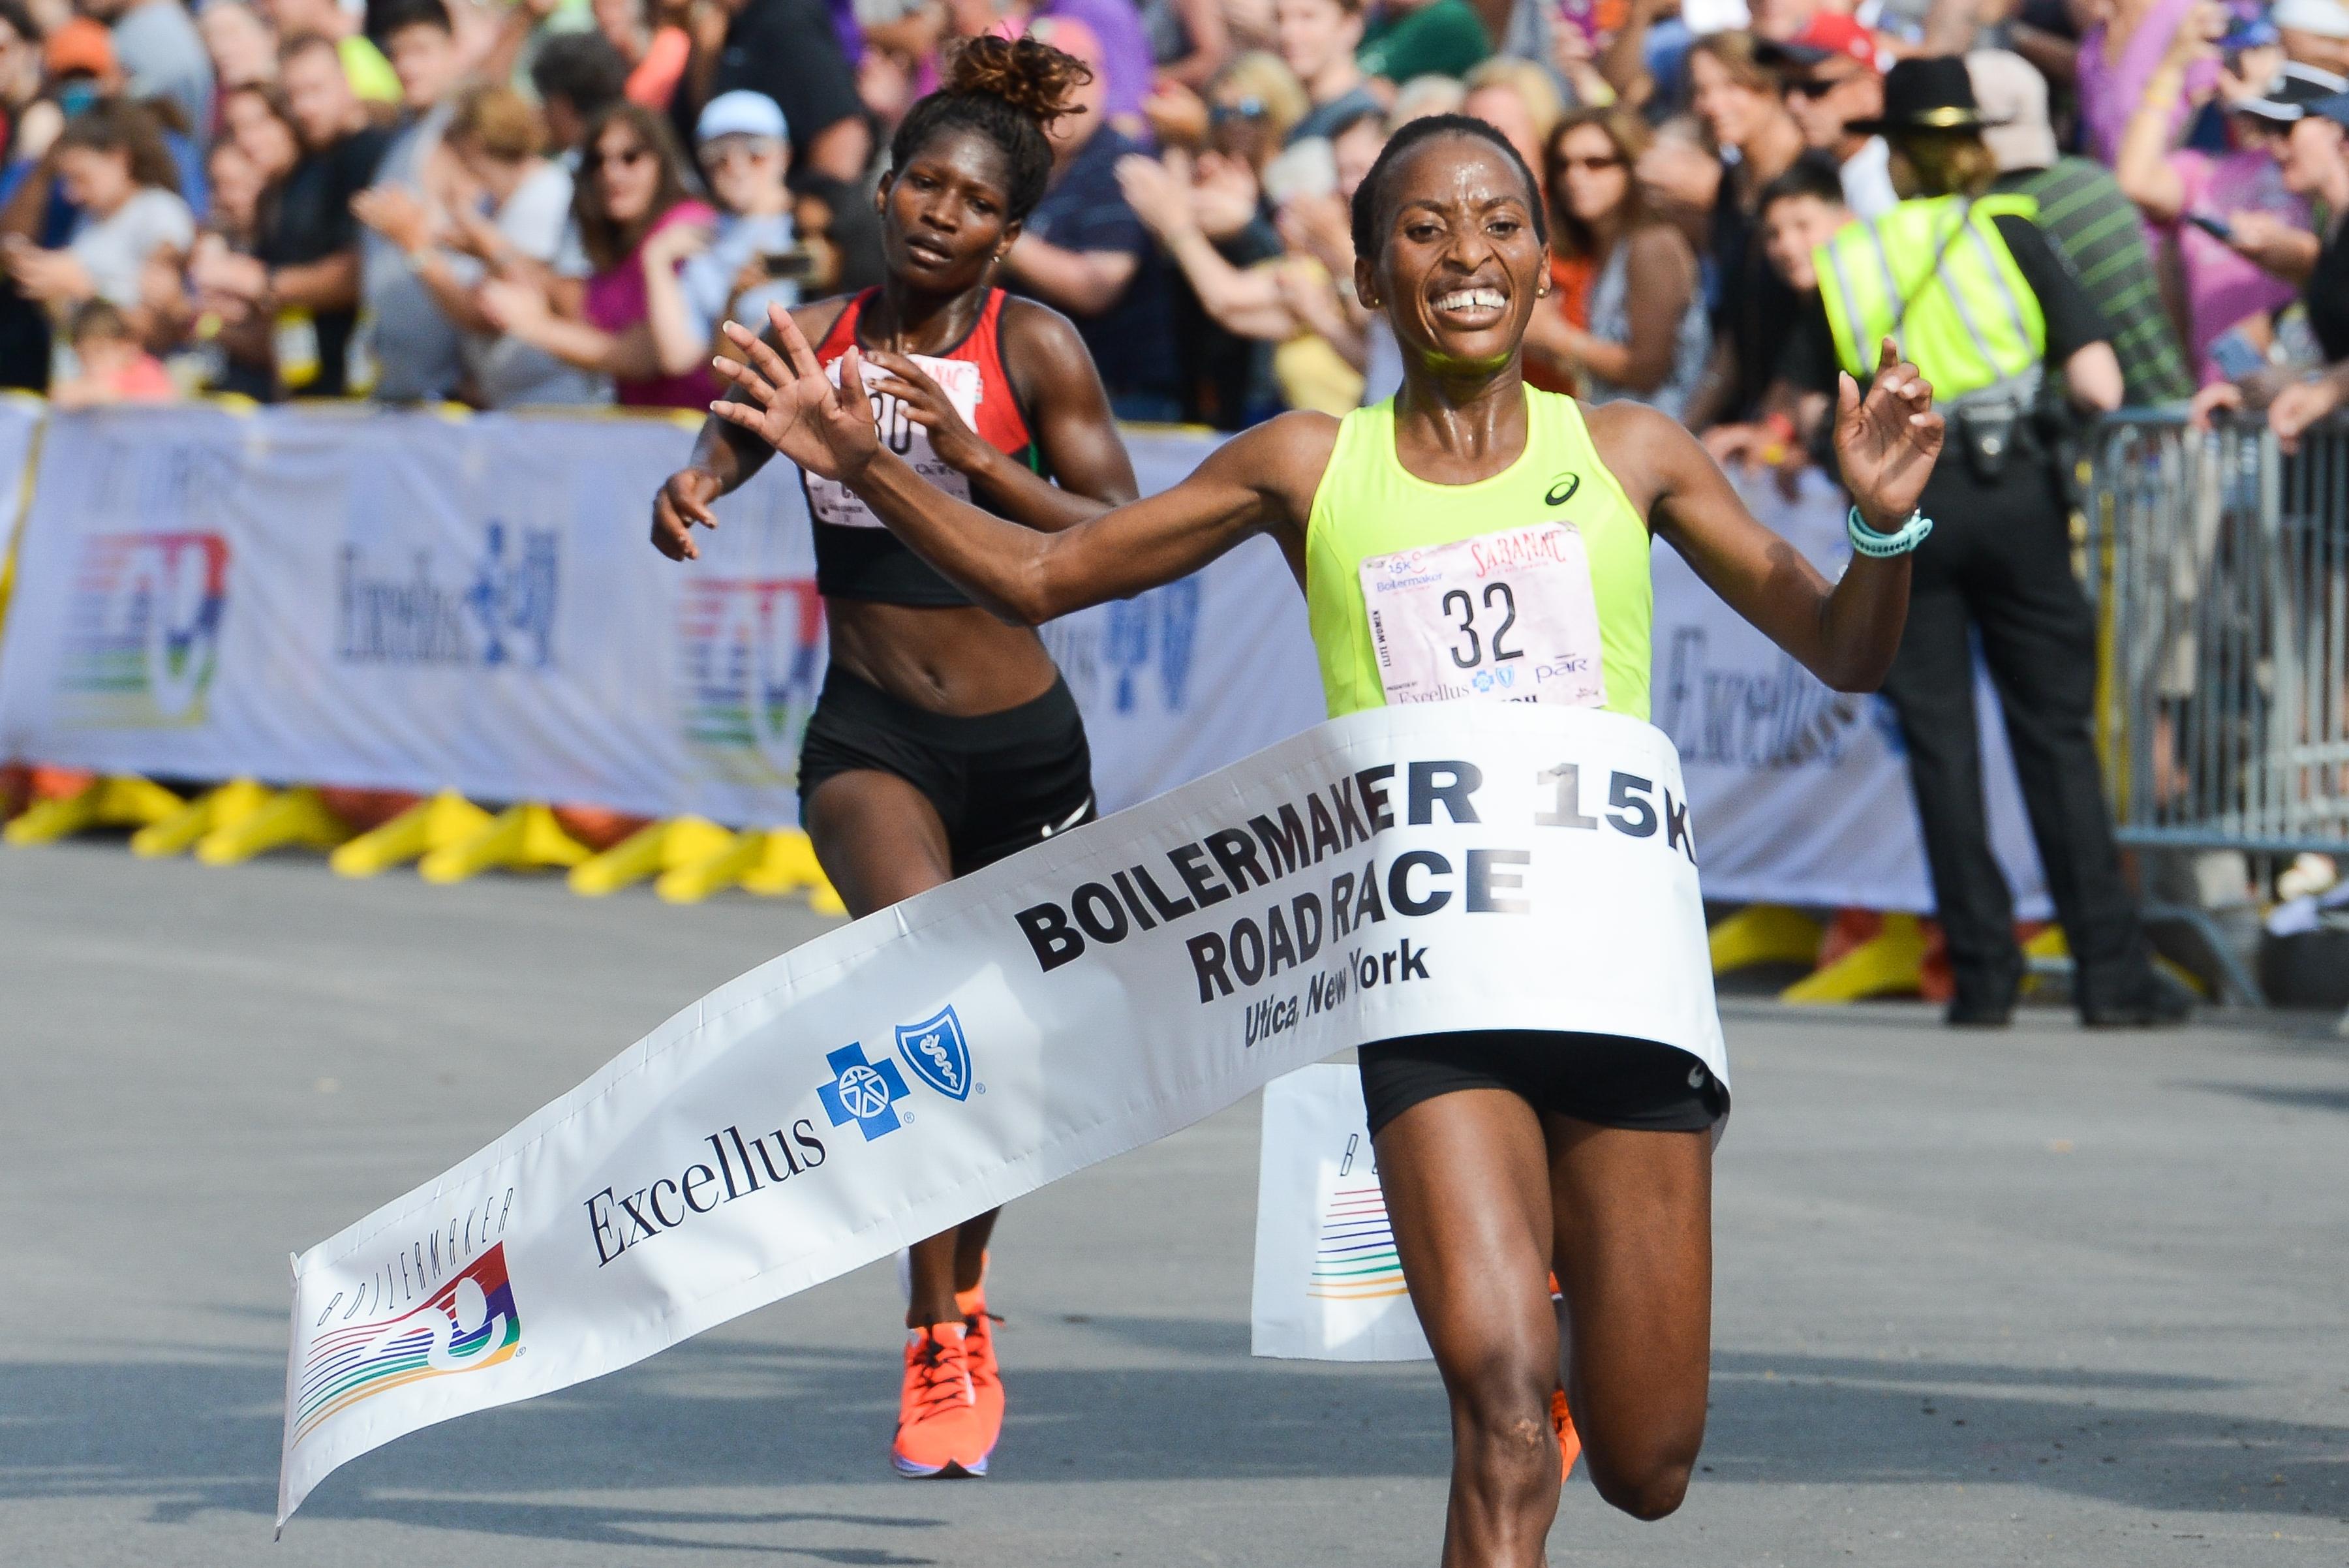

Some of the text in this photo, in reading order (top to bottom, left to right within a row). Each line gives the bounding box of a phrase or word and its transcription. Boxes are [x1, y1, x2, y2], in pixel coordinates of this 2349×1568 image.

[1398, 683, 1470, 703] Excellus
[1442, 581, 1524, 669] 32
[1014, 760, 1698, 973] BOILERMAKER 15K
[1186, 850, 1531, 1004] ROAD RACE
[1245, 938, 1430, 1048] Utica, New York
[316, 1186, 514, 1327] BOILERMAKER
[583, 1118, 826, 1268] Excellus
